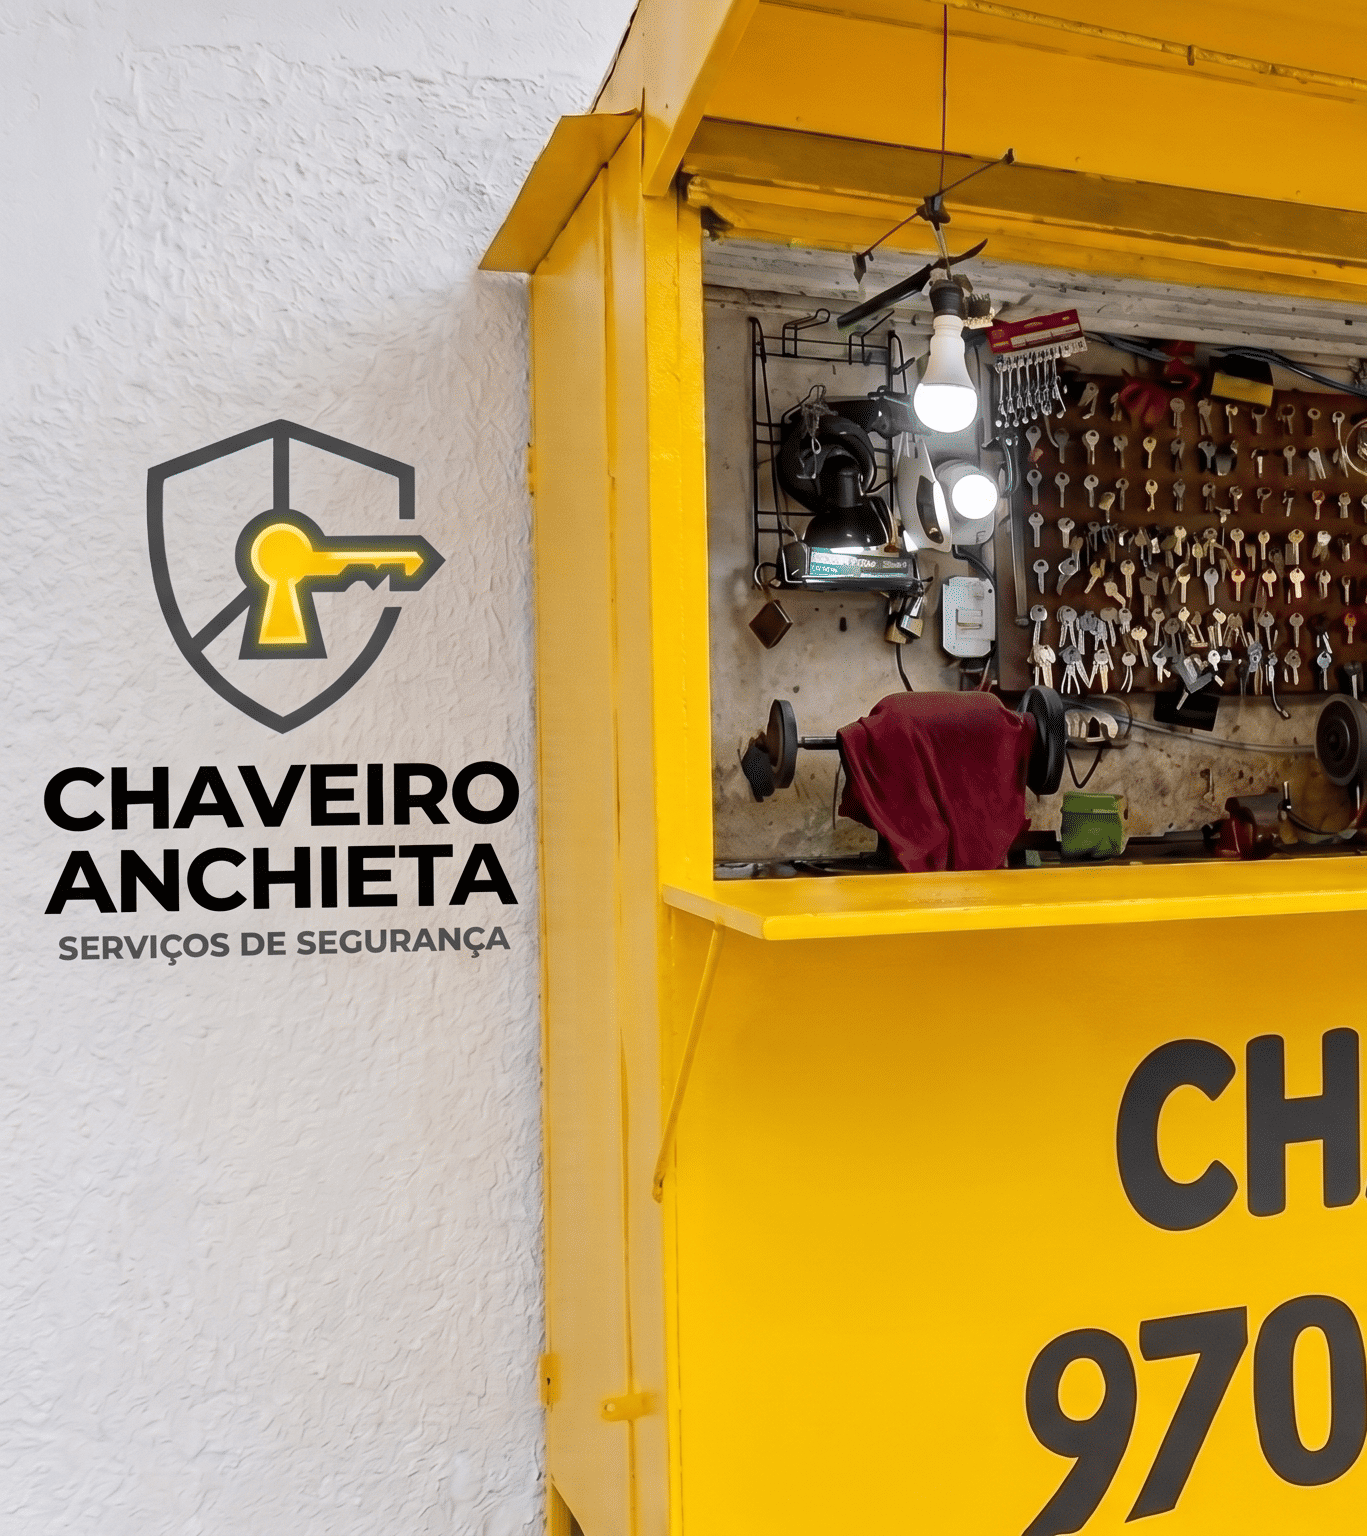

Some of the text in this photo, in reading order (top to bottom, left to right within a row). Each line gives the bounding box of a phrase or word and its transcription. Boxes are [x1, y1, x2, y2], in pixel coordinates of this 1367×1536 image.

[44, 761, 519, 831] CHAVEIRO
[44, 843, 519, 914] ANCHIETA
[59, 926, 511, 966] SERVIÇOS DE SEGURANÇA
